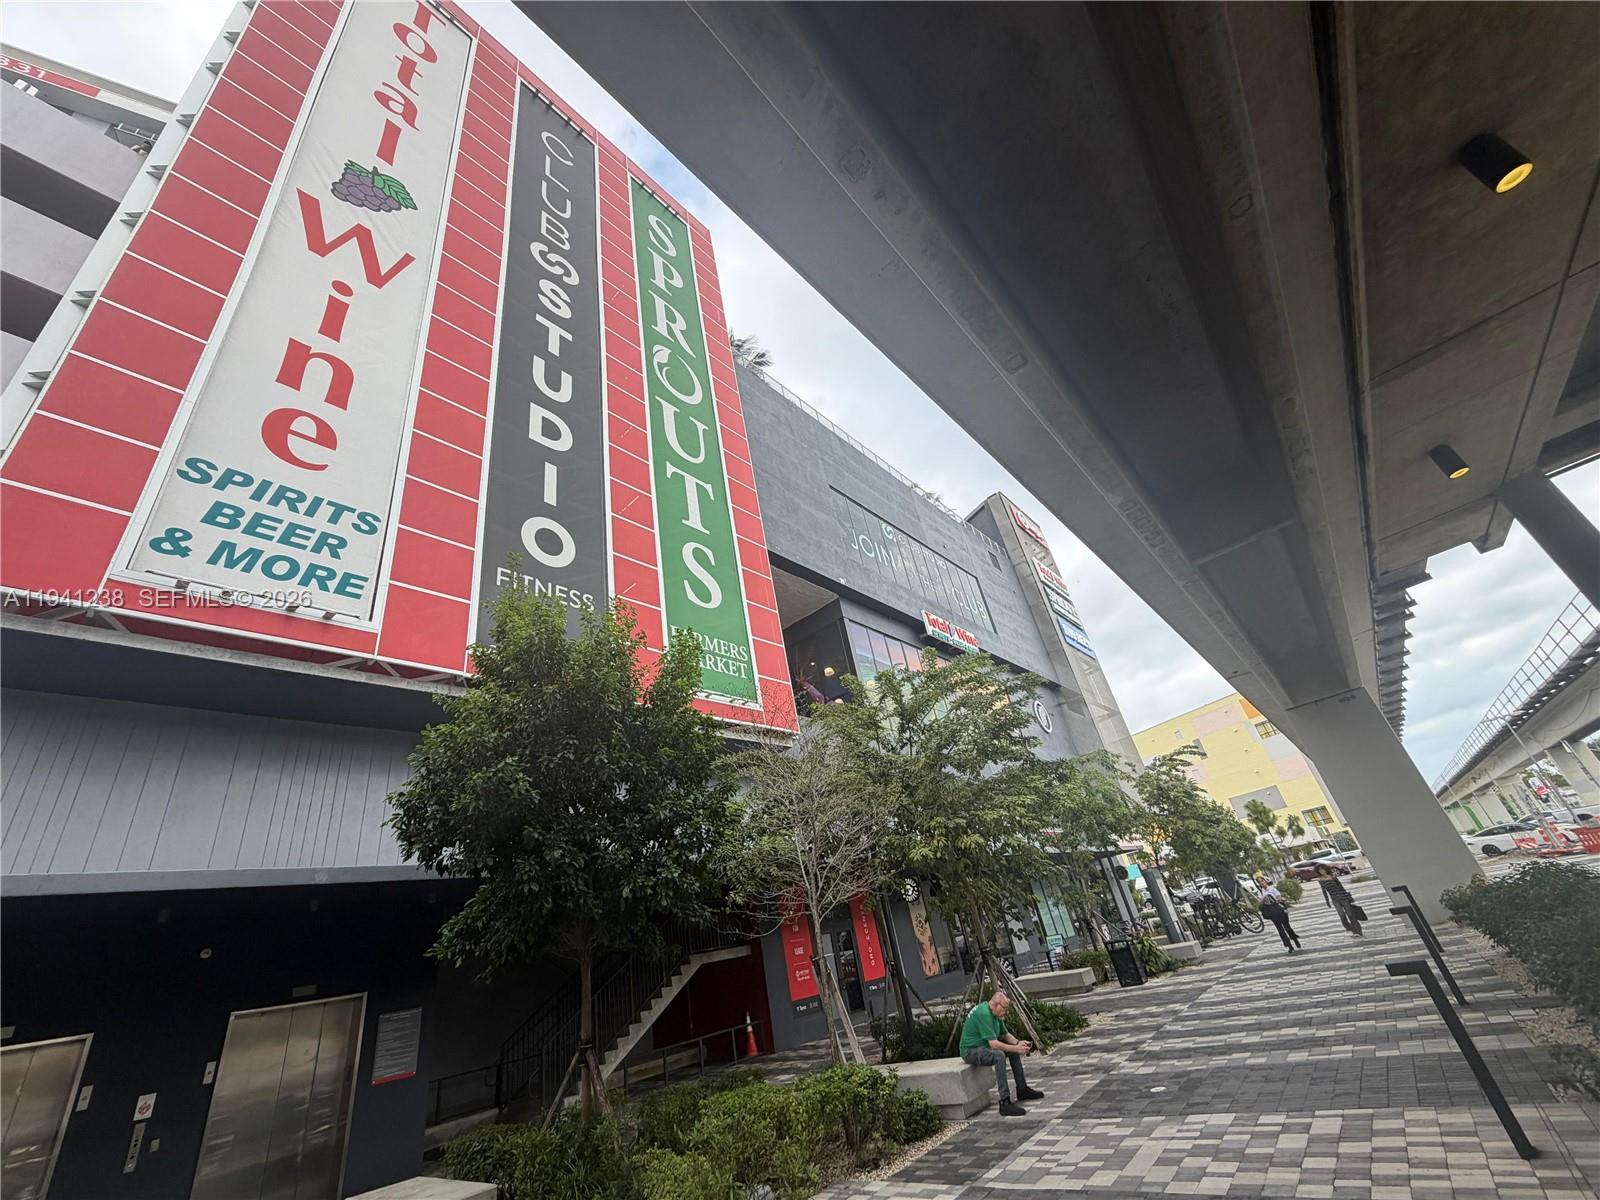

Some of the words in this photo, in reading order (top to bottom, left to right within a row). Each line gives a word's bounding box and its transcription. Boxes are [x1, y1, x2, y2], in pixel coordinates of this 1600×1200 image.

[374, 0, 446, 167] Total
[261, 187, 417, 471] Wine
[647, 213, 723, 609] SPROUTS
[176, 457, 382, 537] SPIRITS
[199, 500, 348, 560] BEER
[148, 527, 194, 558] &
[206, 540, 370, 600] MORE
[496, 567, 595, 611] FITNESS
[851, 529, 897, 571] JOIN
[951, 586, 987, 619] CLUB
[670, 625, 748, 661] FRMERS
[699, 653, 748, 679] RKET
